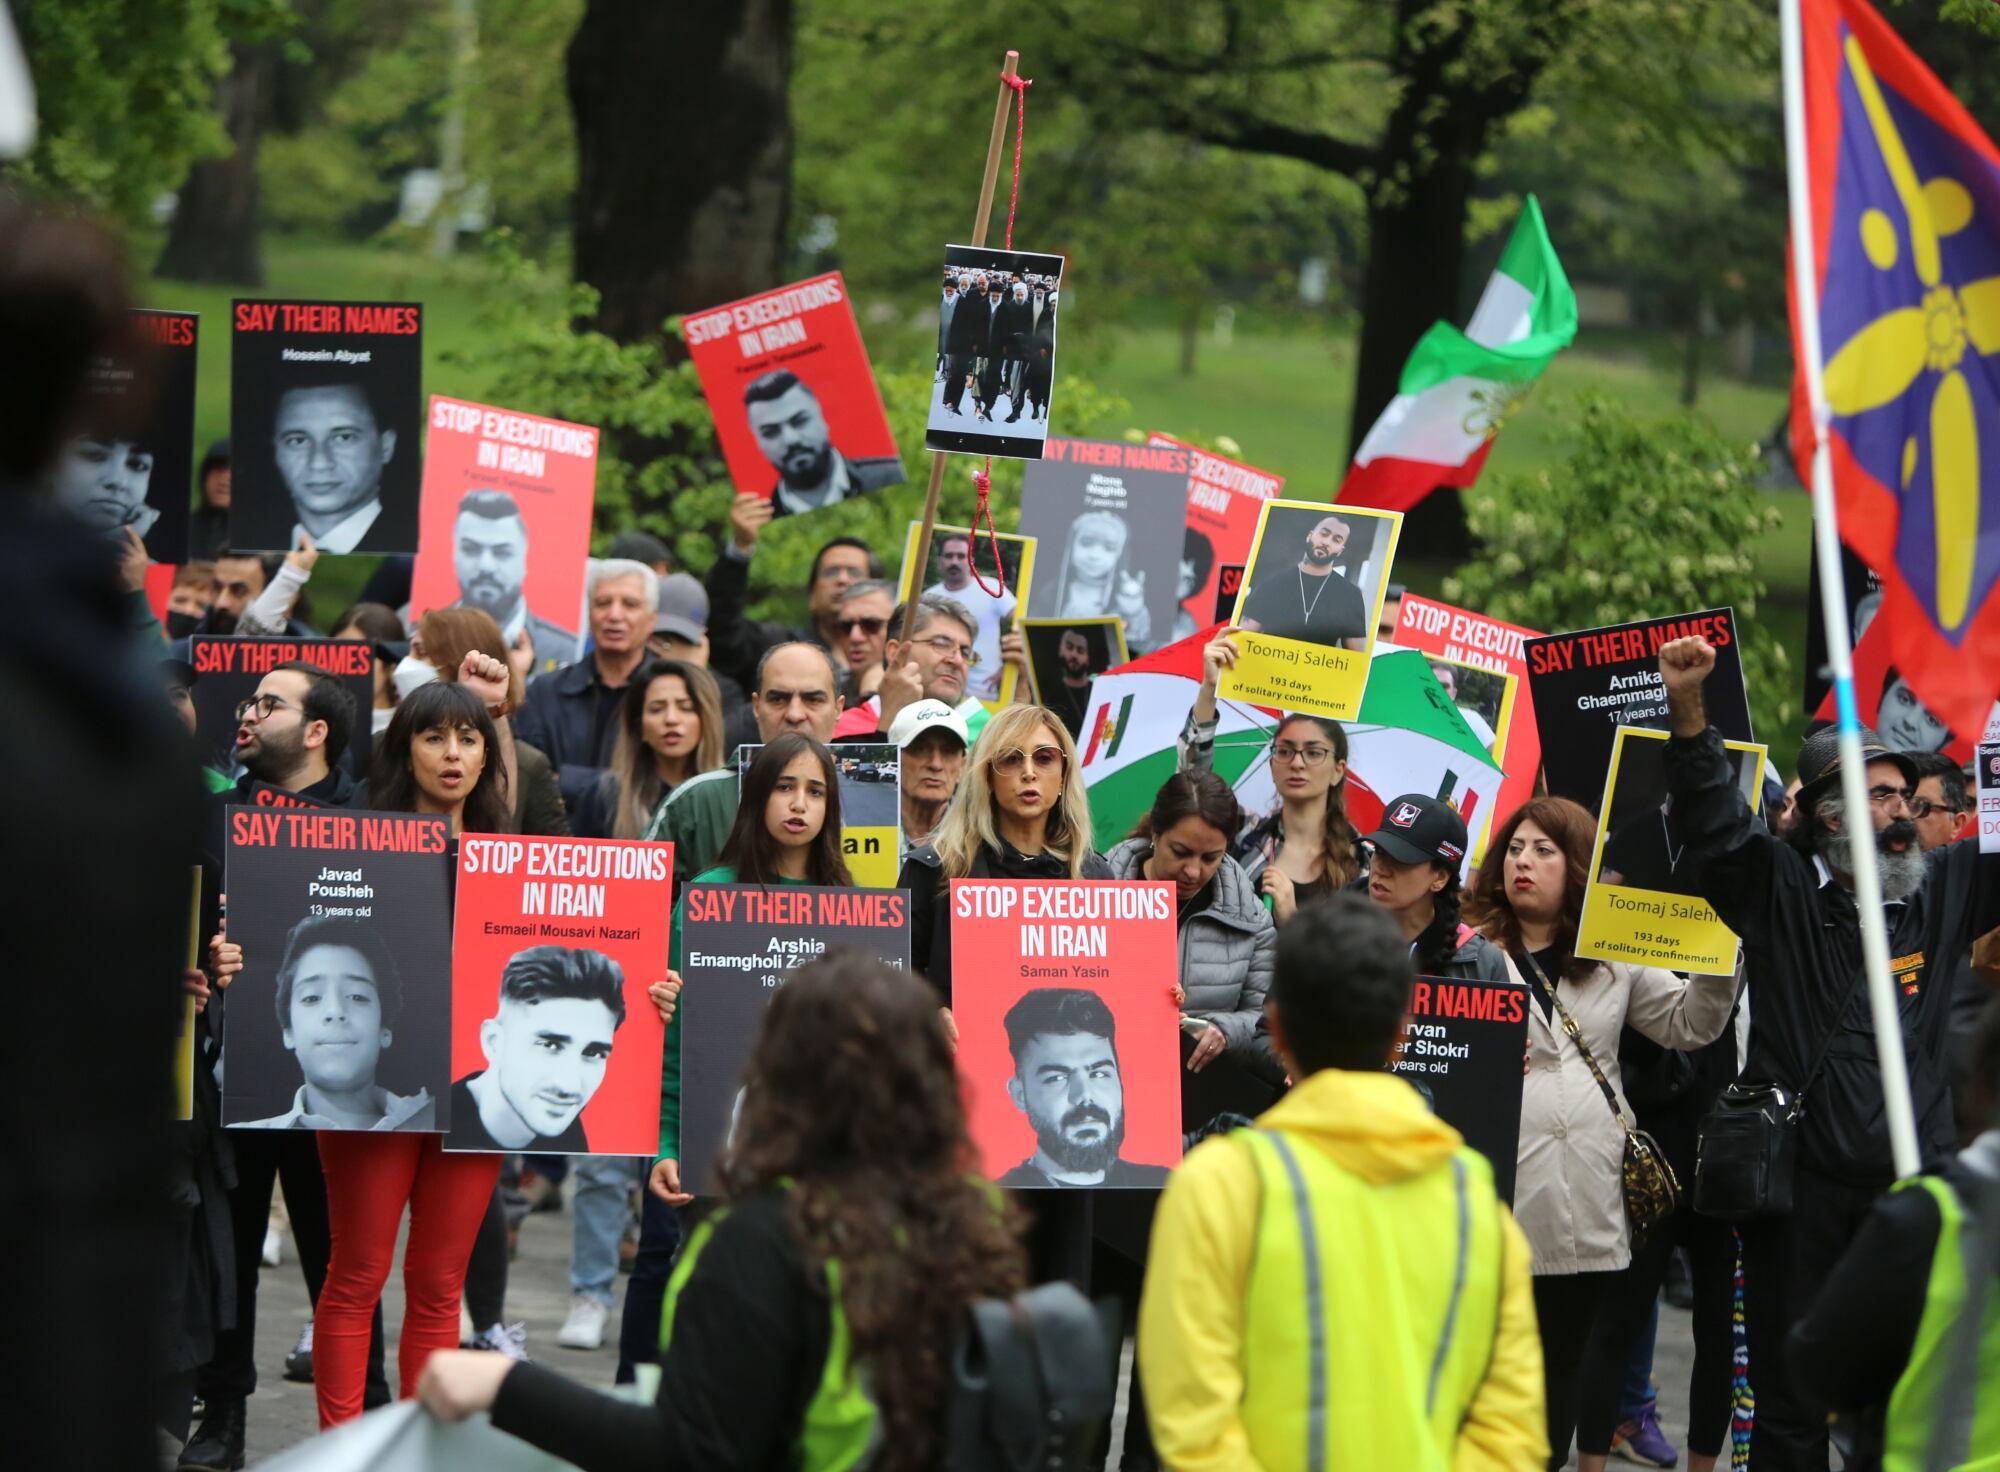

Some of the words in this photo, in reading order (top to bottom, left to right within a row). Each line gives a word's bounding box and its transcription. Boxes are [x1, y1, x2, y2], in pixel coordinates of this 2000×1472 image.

[236, 304, 278, 331] SAY
[282, 305, 341, 333] THEIR
[345, 307, 418, 335] NAMES
[685, 311, 733, 345] STOP
[732, 278, 842, 331] EXECUTIONS
[738, 332, 763, 358] IN
[761, 318, 808, 352] IRAN
[282, 349, 334, 361] Hossein
[433, 402, 482, 434] STOP
[481, 411, 594, 458] EXECUTIONS
[477, 439, 500, 468] IN
[500, 444, 545, 478] IRAN
[1045, 438, 1068, 462] AY
[1071, 440, 1123, 467] THEIR
[1124, 445, 1188, 474] NAMES
[1191, 483, 1232, 515] IRAN
[1403, 601, 1450, 636] STOP
[1450, 614, 1534, 662] EXECUTI
[195, 642, 236, 673] SAY
[1246, 640, 1300, 665] Toomaj
[1304, 651, 1349, 671] Salehi
[1443, 643, 1464, 664] IN
[1531, 639, 1576, 675] SAY
[1577, 630, 1646, 667] THEIR
[1270, 676, 1287, 687] 193
[1289, 679, 1312, 691] days
[1609, 671, 1663, 691] Arnika
[1232, 683, 1243, 692] of
[1245, 685, 1282, 700] solitary
[1284, 693, 1346, 710] confinement
[1608, 711, 1622, 723] 17
[1625, 708, 1655, 724] years
[1659, 704, 1669, 715] ol
[232, 812, 282, 847] SAY
[286, 815, 356, 850] THEIR
[362, 818, 446, 854] NAMES
[843, 838, 880, 854] an
[464, 840, 523, 874] STOP
[527, 842, 667, 881] EXECUTIONS
[318, 867, 362, 882] Javad
[309, 883, 373, 898] Pousheh
[522, 882, 545, 915] IN
[550, 883, 605, 917] IRAN
[956, 885, 1017, 918] STOP
[1023, 887, 1169, 920] EXECUTIONS
[309, 904, 323, 916] 13
[325, 907, 353, 918] years
[356, 906, 371, 917] old
[688, 889, 737, 922] SAY
[742, 891, 812, 924] THEIR
[819, 894, 904, 928] NAMES
[1608, 894, 1666, 918] Toomaj
[484, 922, 536, 936] Esmaeil
[540, 924, 595, 938] Mousavi
[600, 926, 640, 940] Nazari
[1020, 925, 1044, 957] IN
[1051, 925, 1107, 957] IRAN
[1634, 931, 1652, 942] 193
[1655, 934, 1680, 947] days
[767, 937, 825, 954] Arshia
[1594, 940, 1606, 949] of
[1607, 943, 1648, 957] solitary
[1651, 950, 1719, 965] confinement
[690, 952, 782, 971] Emamgholi
[1020, 965, 1068, 978] Saman
[1071, 965, 1110, 978] Yasin
[760, 975, 775, 987] 16
[1436, 984, 1525, 1023] NAMES
[1402, 1023, 1446, 1038] rvan
[1415, 1040, 1469, 1058] Shokri
[1392, 1060, 1426, 1073] years
[1430, 1062, 1449, 1074] old
